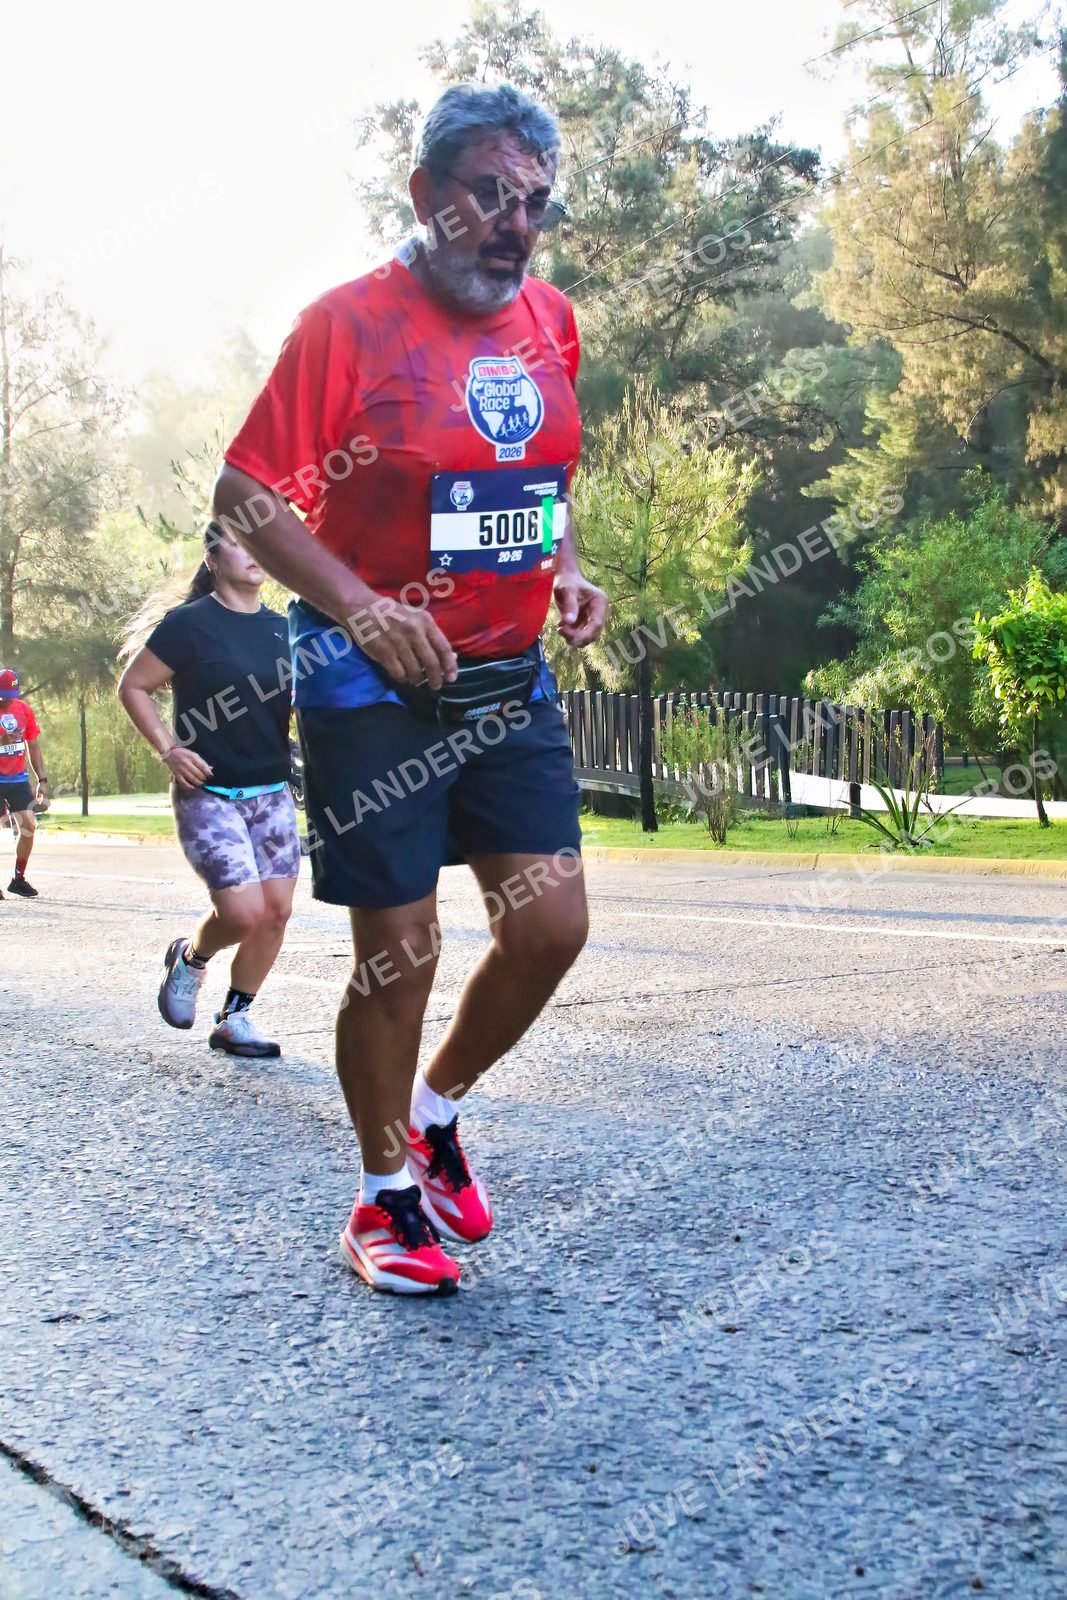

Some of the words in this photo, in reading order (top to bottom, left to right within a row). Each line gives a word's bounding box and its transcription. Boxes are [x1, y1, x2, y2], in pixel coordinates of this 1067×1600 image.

[478, 365, 518, 377] BIMBO
[484, 380, 522, 397] Global
[480, 397, 511, 411] Race
[499, 446, 523, 459] 2026
[479, 510, 538, 546] 5006
